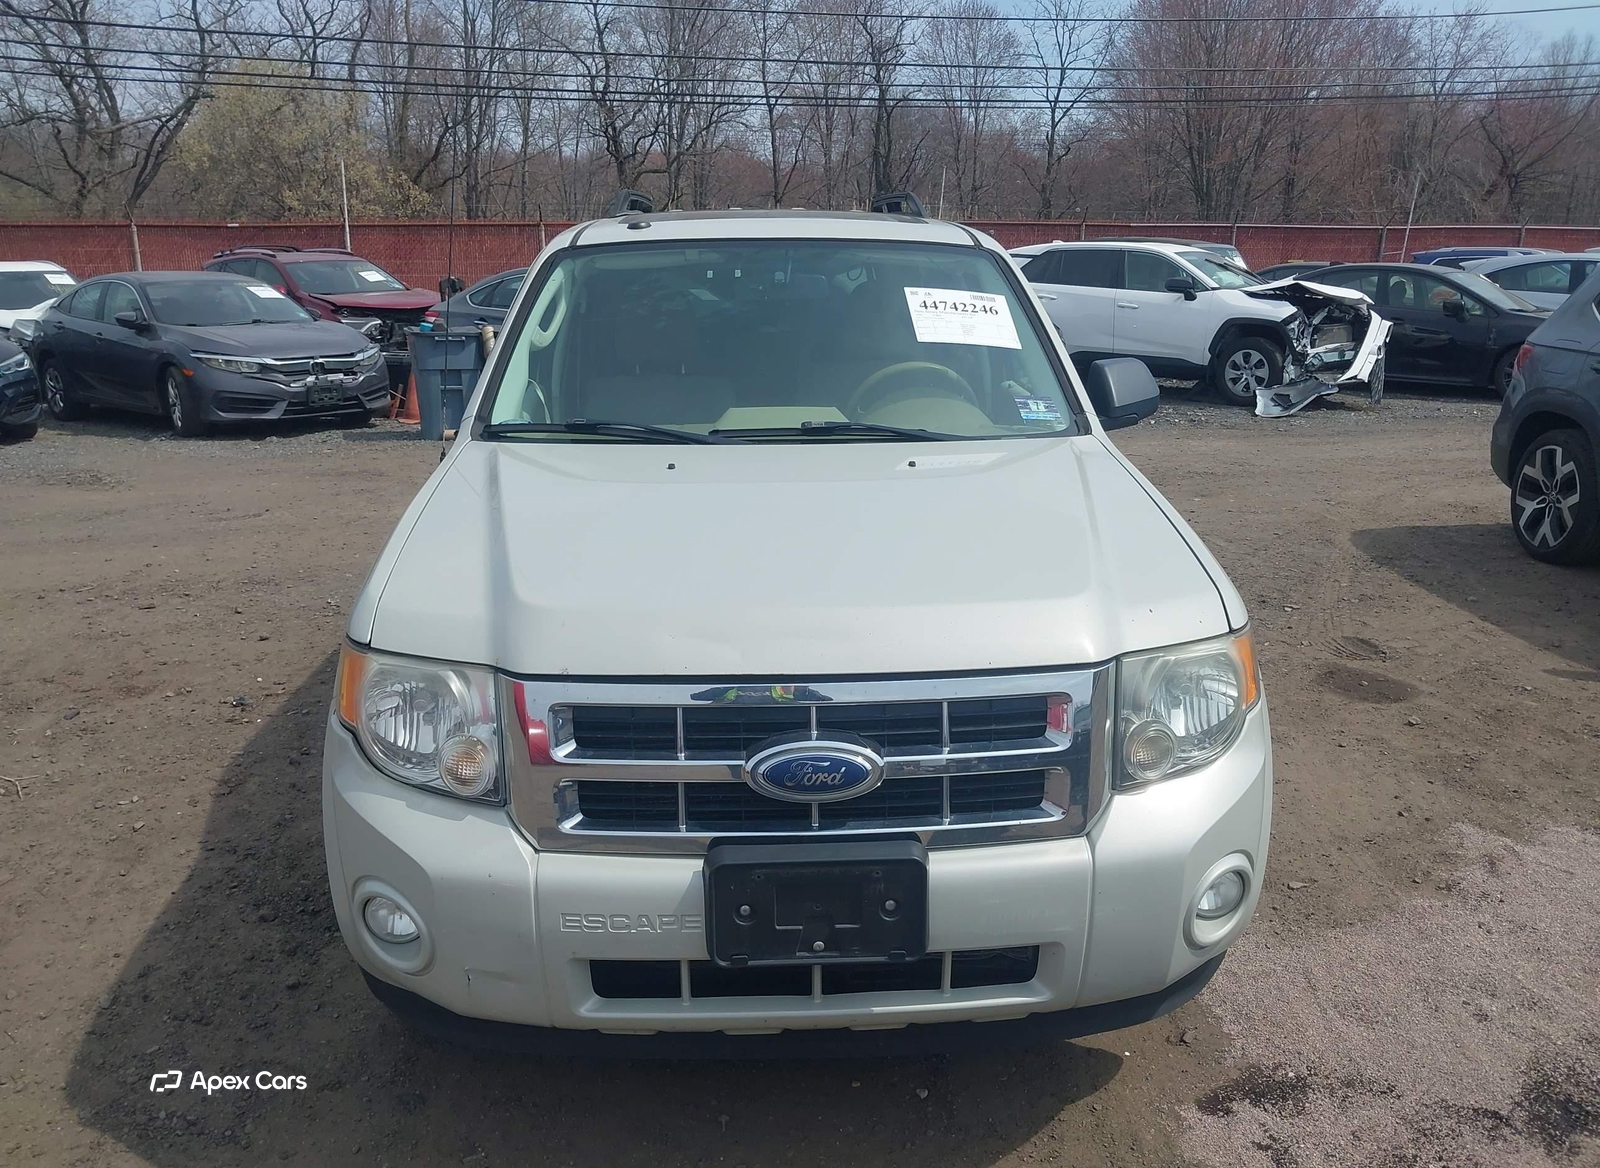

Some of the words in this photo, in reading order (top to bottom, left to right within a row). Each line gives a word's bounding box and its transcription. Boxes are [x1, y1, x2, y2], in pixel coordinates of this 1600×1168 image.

[919, 299, 999, 316] 44742246
[784, 760, 846, 786] Ford
[560, 913, 702, 933] ESCAPE
